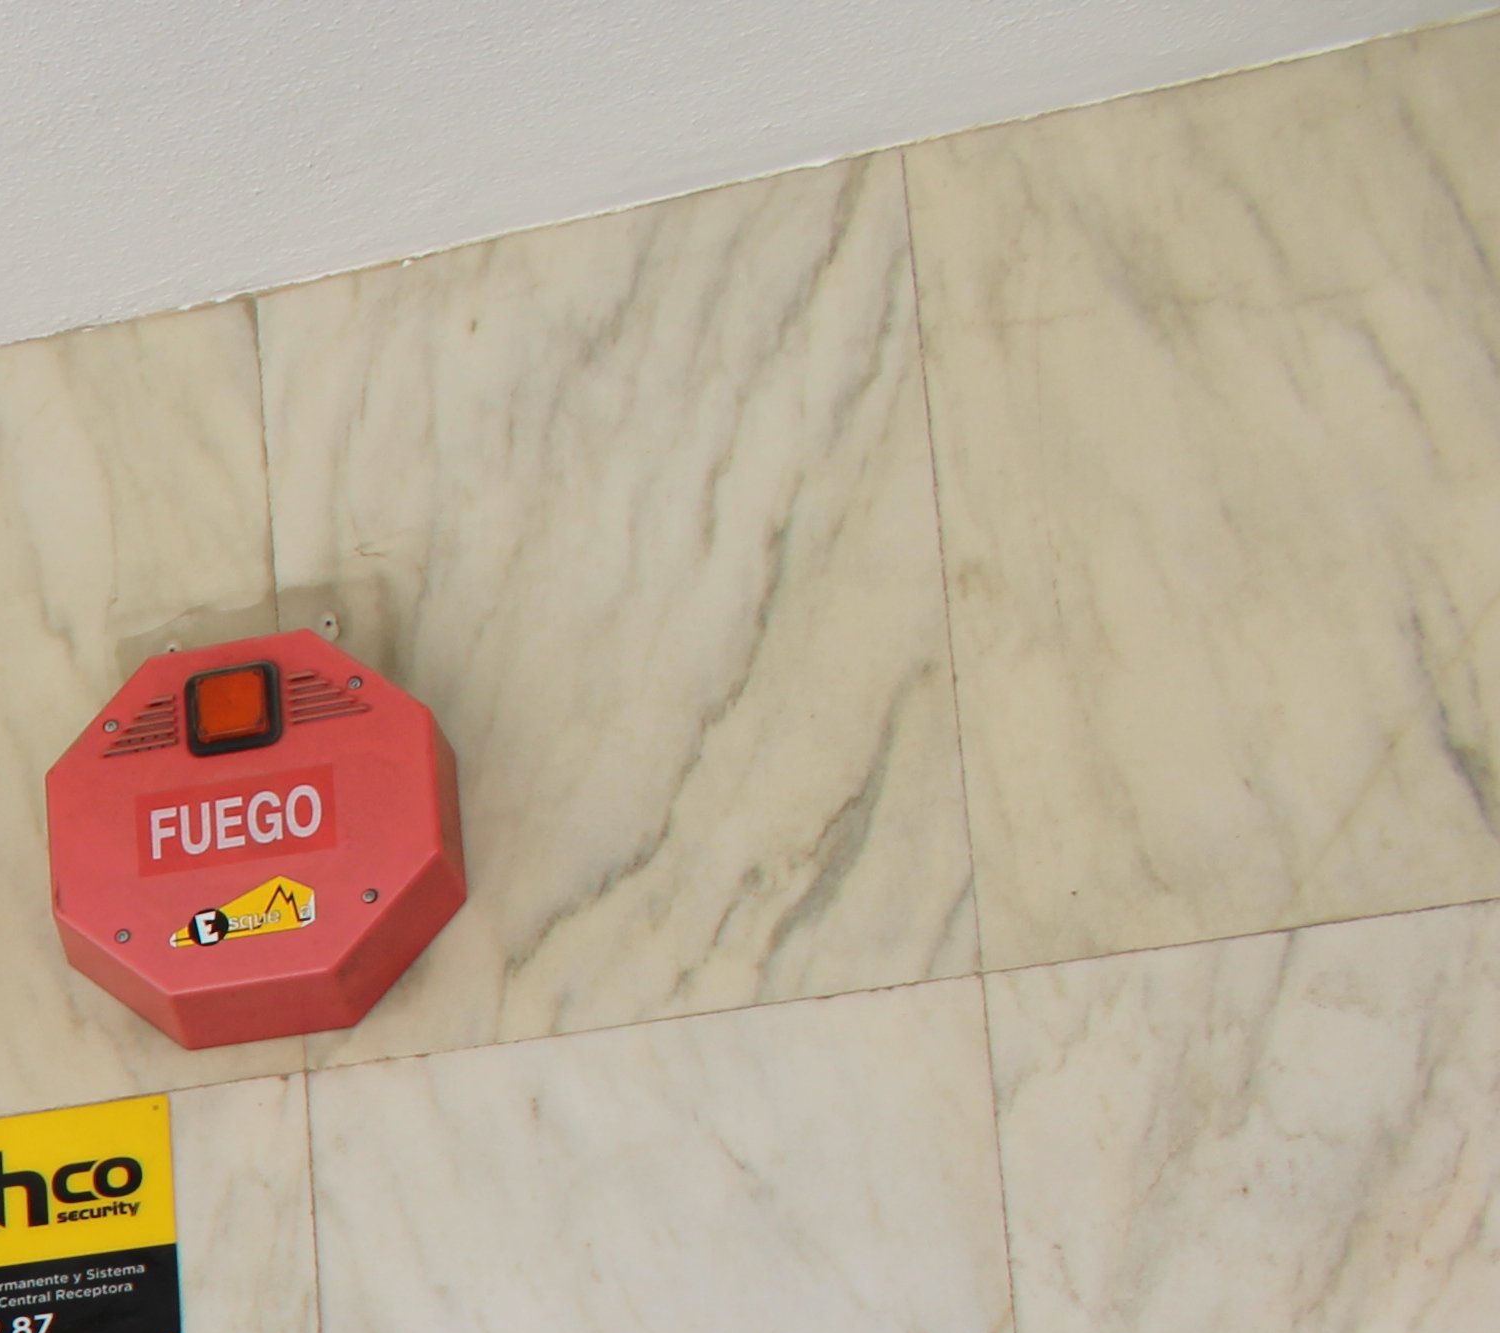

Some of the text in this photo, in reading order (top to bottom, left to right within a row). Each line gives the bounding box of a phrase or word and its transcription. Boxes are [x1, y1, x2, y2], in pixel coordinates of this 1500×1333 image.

[150, 784, 322, 859] FUEGO
[57, 1201, 141, 1224] security
[73, 1273, 82, 1284] y
[86, 1264, 145, 1281] Sistema
[56, 1282, 134, 1301] Receptora
